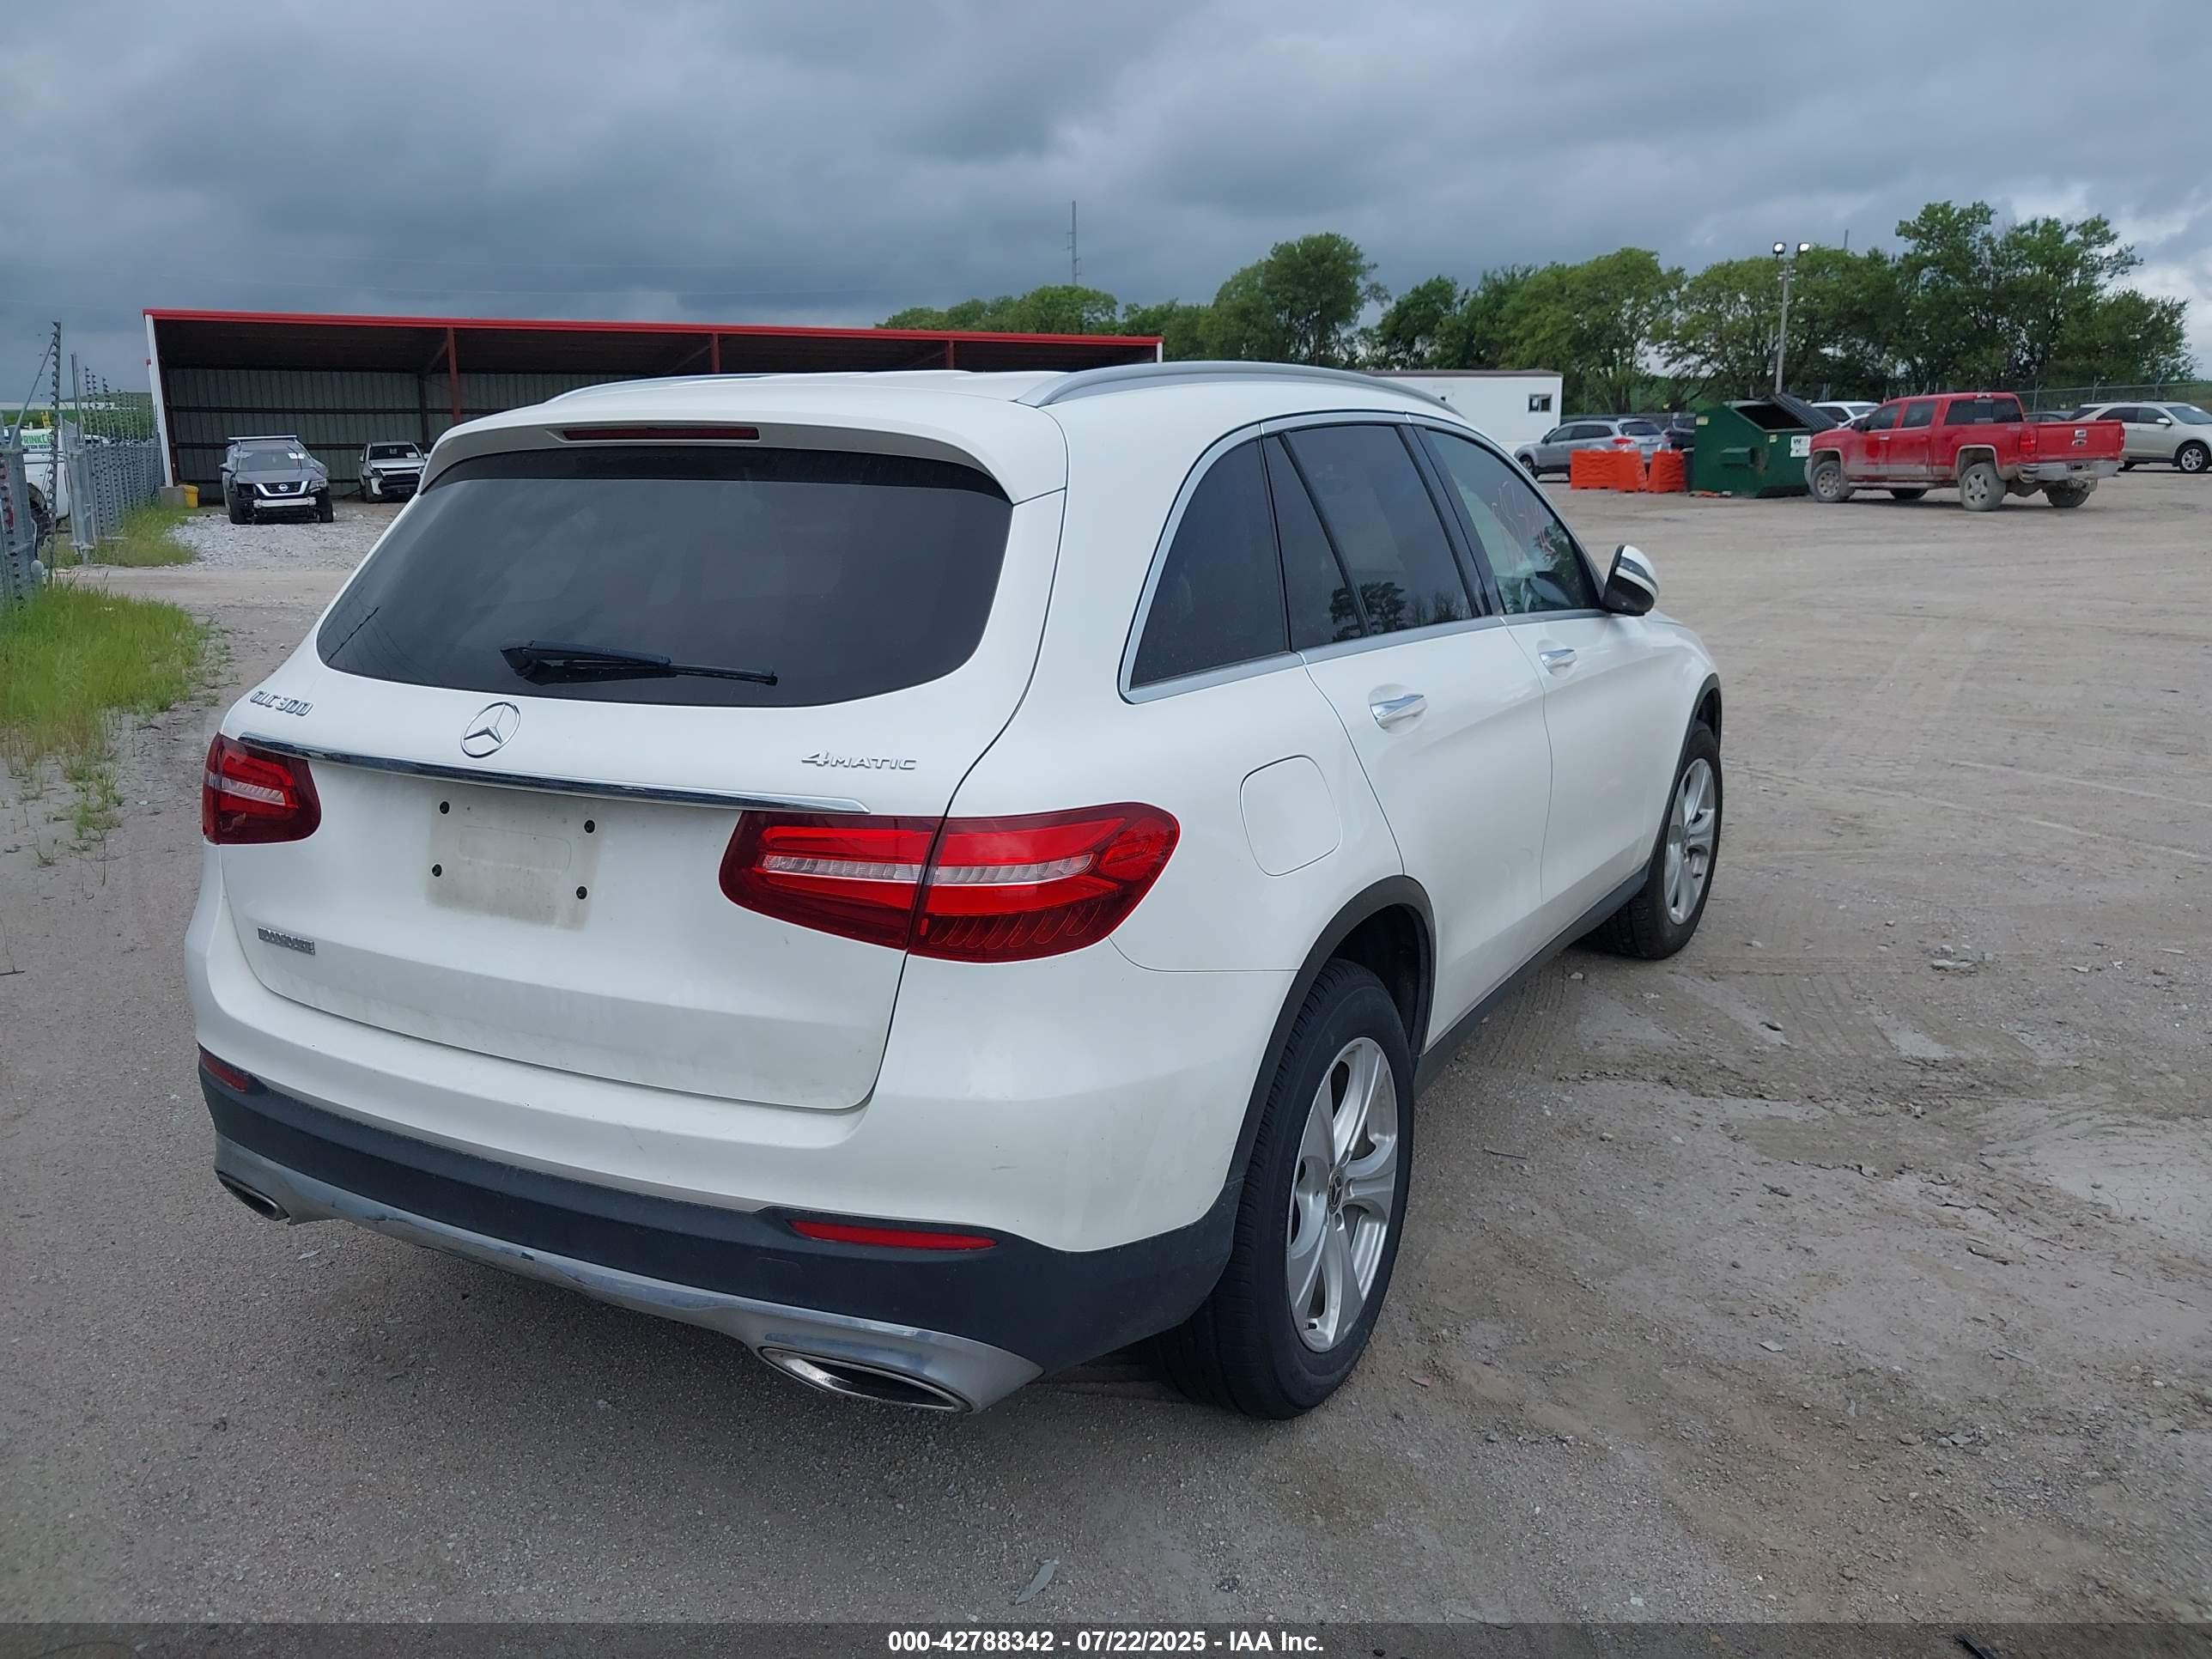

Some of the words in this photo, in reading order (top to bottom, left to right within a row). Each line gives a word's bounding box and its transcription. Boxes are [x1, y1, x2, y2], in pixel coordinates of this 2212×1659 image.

[249, 690, 281, 708] GLC
[275, 696, 313, 717] 300
[801, 750, 917, 770] 4MATIC
